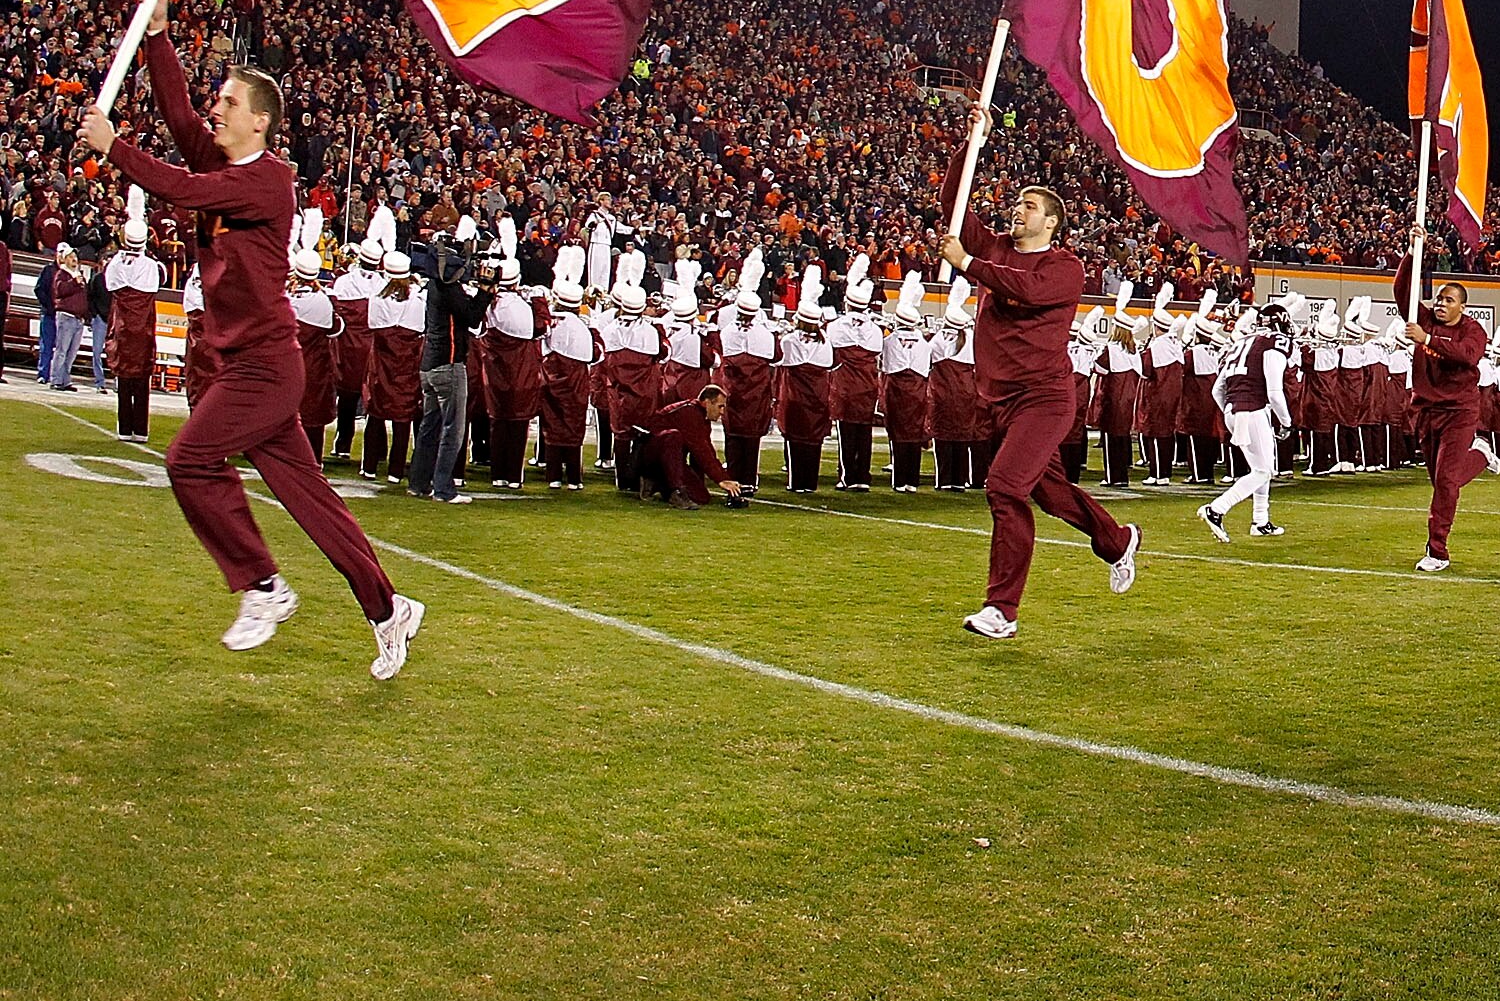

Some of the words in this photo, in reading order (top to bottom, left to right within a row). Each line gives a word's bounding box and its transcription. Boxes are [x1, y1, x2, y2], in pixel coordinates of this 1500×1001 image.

[1280, 279, 1289, 293] G
[1469, 310, 1490, 320] 2003
[1226, 336, 1256, 377] 21
